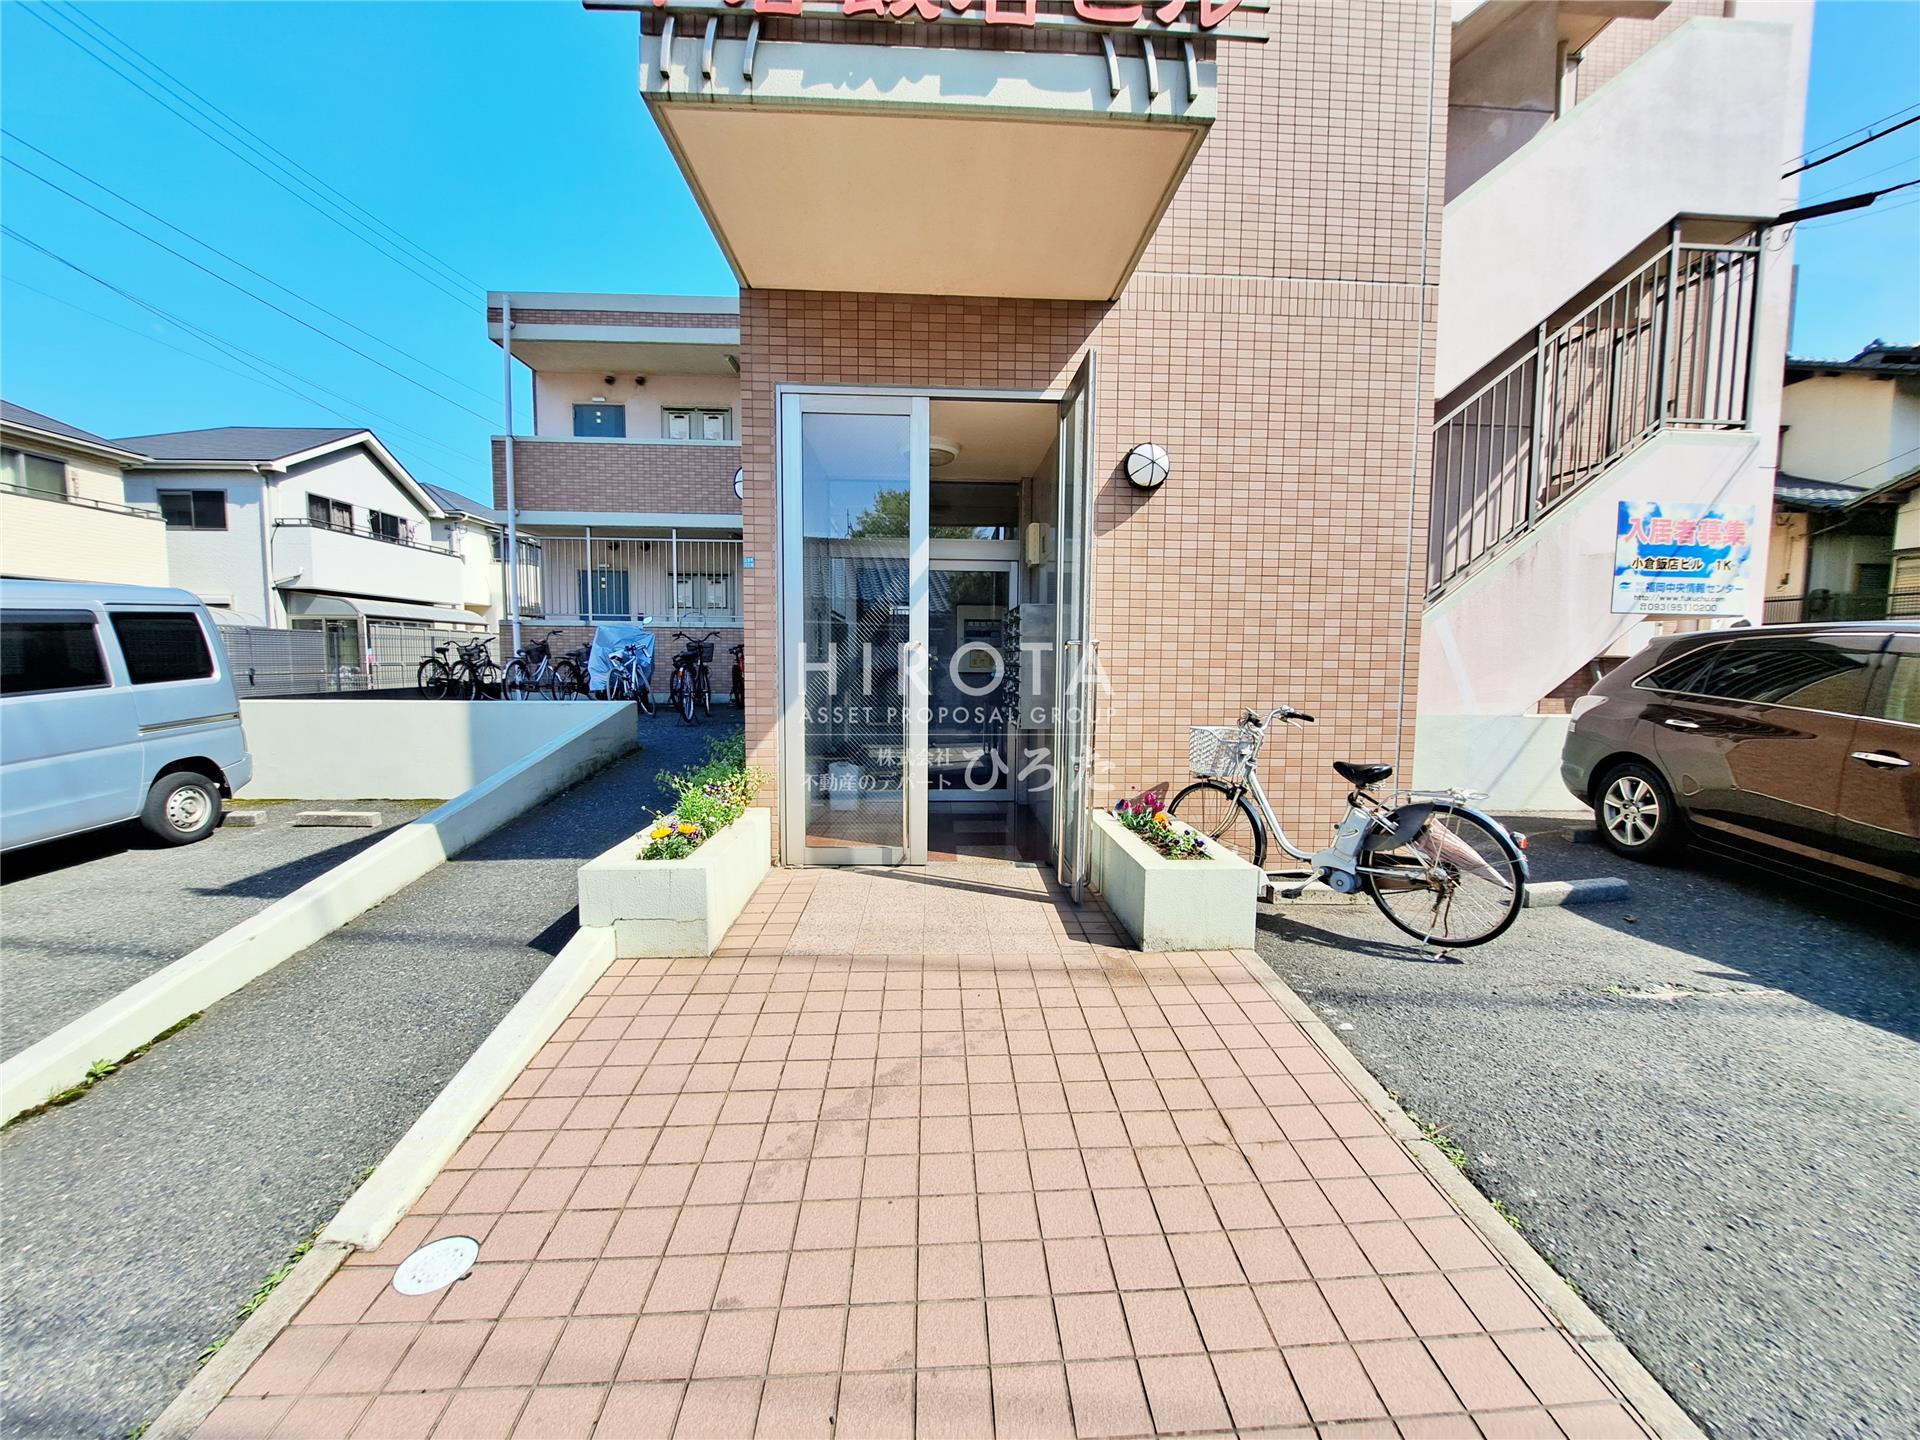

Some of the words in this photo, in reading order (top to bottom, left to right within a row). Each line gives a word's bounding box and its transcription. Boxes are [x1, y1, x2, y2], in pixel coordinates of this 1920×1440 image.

[1624, 518, 1747, 546] 入居者募集
[1632, 557, 1703, 571] 小倉飯店ビル
[1716, 560, 1732, 571] 1K
